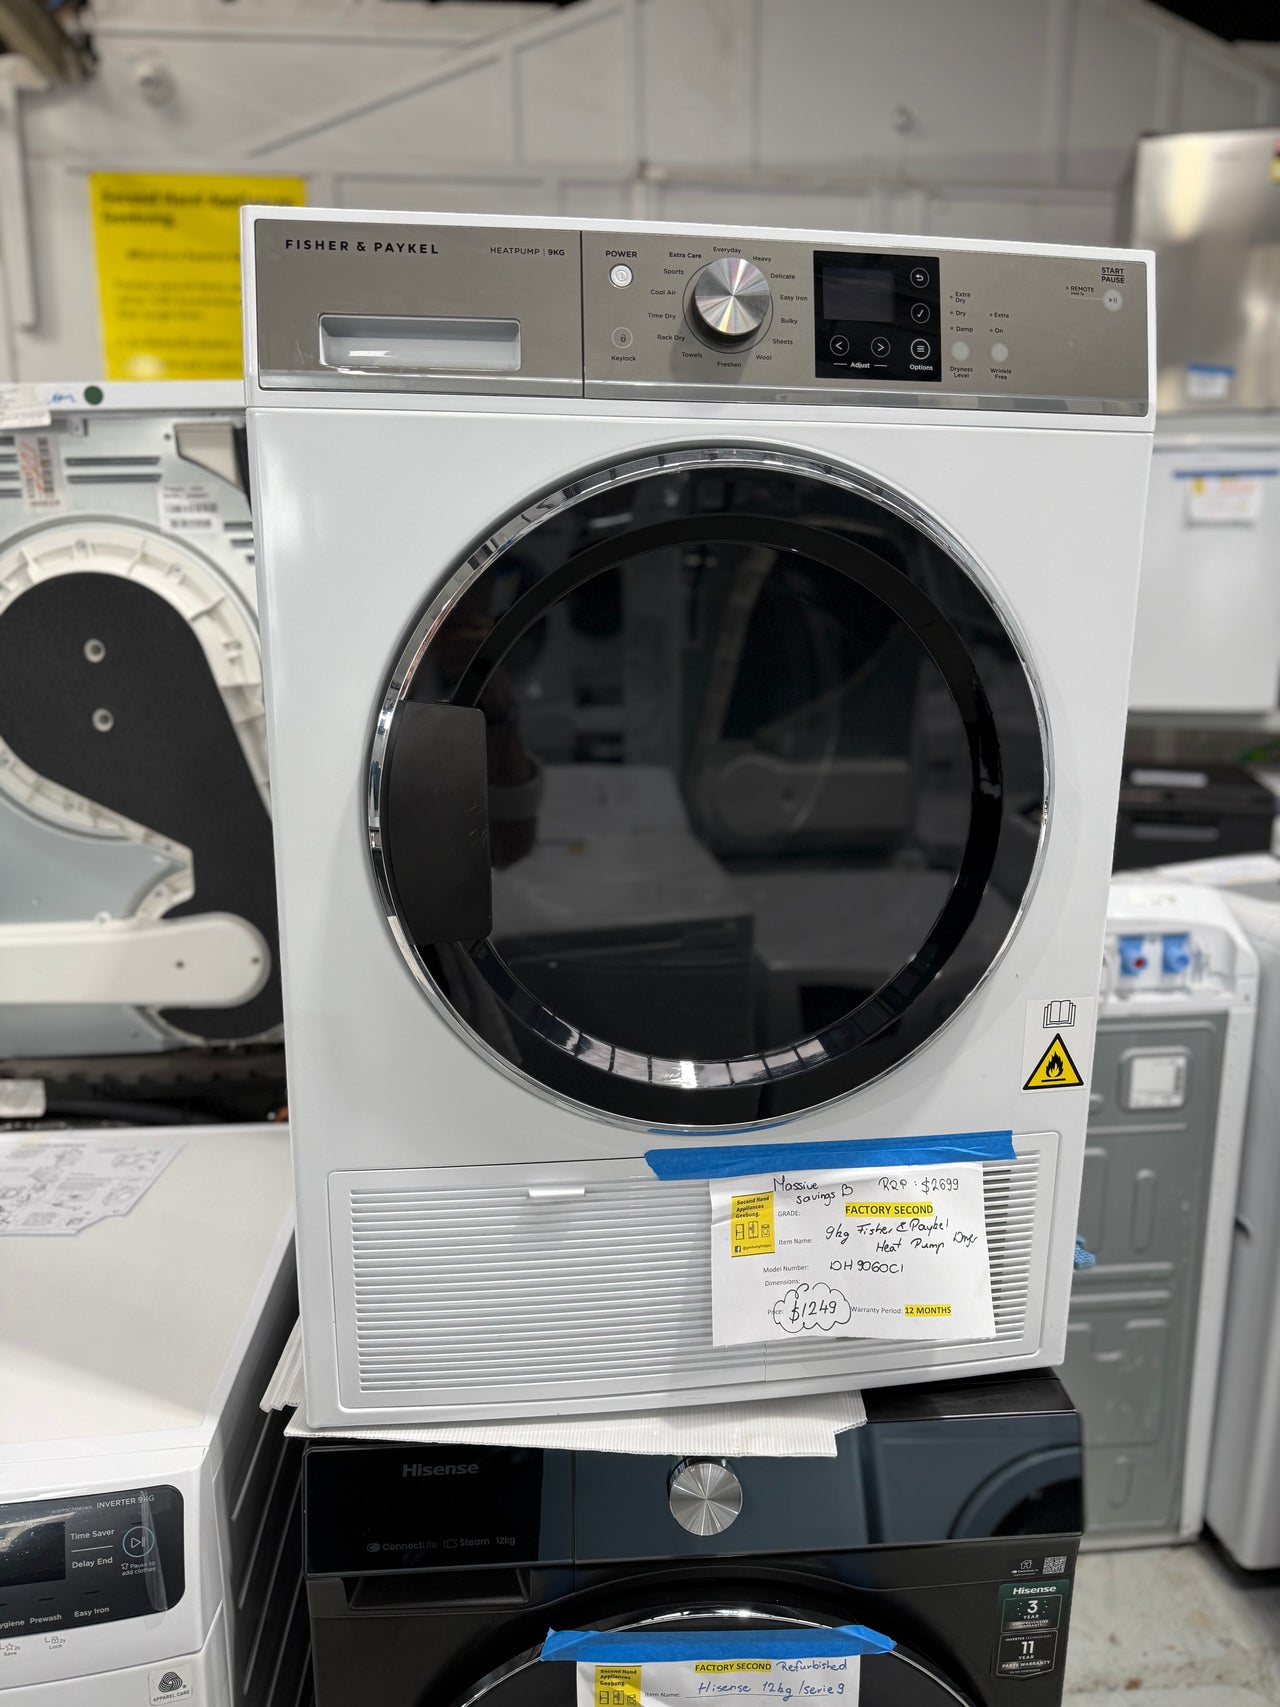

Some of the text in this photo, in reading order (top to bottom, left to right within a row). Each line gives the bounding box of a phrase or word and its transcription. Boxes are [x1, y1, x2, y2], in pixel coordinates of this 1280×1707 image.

[285, 239, 439, 254] FISHER & PAYKEL
[713, 246, 741, 254] Everyday
[490, 247, 565, 256] HEATPUMP 9KG
[605, 250, 637, 258] POWER
[669, 251, 686, 259] Extra
[752, 255, 772, 263] Heavy
[663, 268, 684, 276] Sports
[1101, 266, 1125, 274] START
[770, 272, 796, 280] Delicate
[1101, 275, 1125, 284] PAUSE
[650, 288, 666, 296] Cool
[1070, 285, 1095, 293] REMOTE
[780, 294, 794, 303] Easy
[780, 317, 798, 325] Bulky
[674, 334, 686, 342] Dry
[850, 361, 870, 370] Adjust
[909, 363, 933, 371] Options
[773, 1174, 819, 1192] Massive
[921, 1176, 959, 1195] $2699
[796, 1191, 836, 1207] savings
[845, 1204, 933, 1215] FACTORY SECOND
[825, 1223, 850, 1245] 9kg
[857, 1222, 893, 1236] Fisher
[875, 1237, 902, 1253] Heat
[910, 1237, 945, 1255] Pump
[783, 1264, 809, 1272] Number:
[764, 1278, 801, 1287] Dimensions:
[789, 1299, 837, 1324] $1249
[851, 1306, 952, 1315] Warranty Period: 12 MONTHS
[402, 1463, 479, 1477] Hisense
[96, 1494, 155, 1509] INVERTER 9KG
[70, 1529, 115, 1541] Time Saver
[382, 1536, 516, 1551] ConnectLife Steam 12kg
[72, 1556, 113, 1569] Delay End
[134, 1567, 156, 1575] clothes
[1013, 1585, 1057, 1595] Hisense
[1027, 1600, 1038, 1613] 3
[30, 1614, 62, 1624] Prewash
[74, 1610, 92, 1618] Easy
[94, 1606, 110, 1614] Iron
[1021, 1641, 1035, 1655] 11
[695, 1658, 848, 1672] FACTORY SECOND Refurbished
[1002, 1661, 1019, 1669] PARTS
[153, 1689, 191, 1703] APPAREL CARE
[698, 1681, 752, 1695] Hisense
[762, 1681, 794, 1702] 12kg
